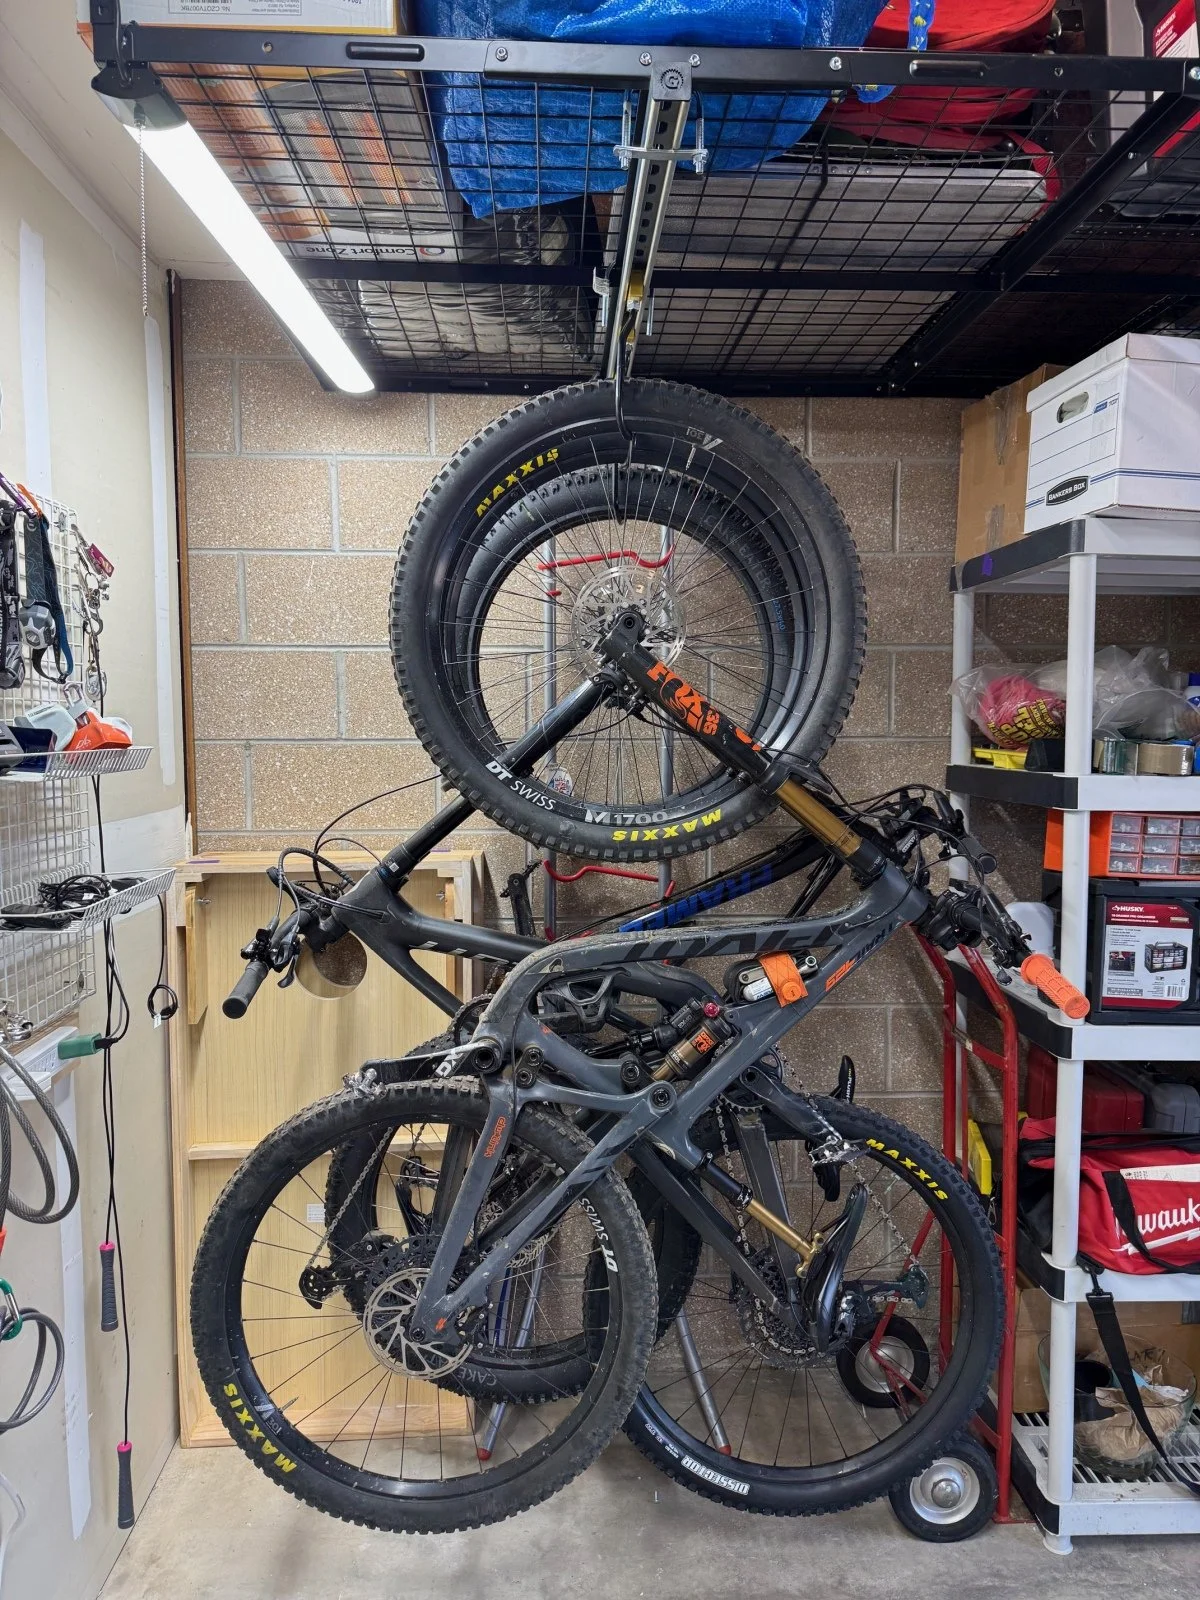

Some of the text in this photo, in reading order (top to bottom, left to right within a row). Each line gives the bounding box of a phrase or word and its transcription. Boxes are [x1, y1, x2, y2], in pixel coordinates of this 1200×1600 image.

[305, 246, 417, 256] Comfort Zone
[476, 448, 559, 518] MAXXIS
[1048, 481, 1086, 501] BANKERS BOX
[646, 661, 705, 733] FOX
[485, 761, 515, 781] DT
[510, 780, 557, 811] SWISS
[612, 808, 722, 842] MAXXIS
[613, 811, 670, 827] 1700
[865, 1139, 948, 1200] MAXXIS
[578, 1198, 619, 1272] DT SWISS
[223, 1383, 297, 1473] MAXXIS
[681, 1455, 750, 1496] DISSECTOR
